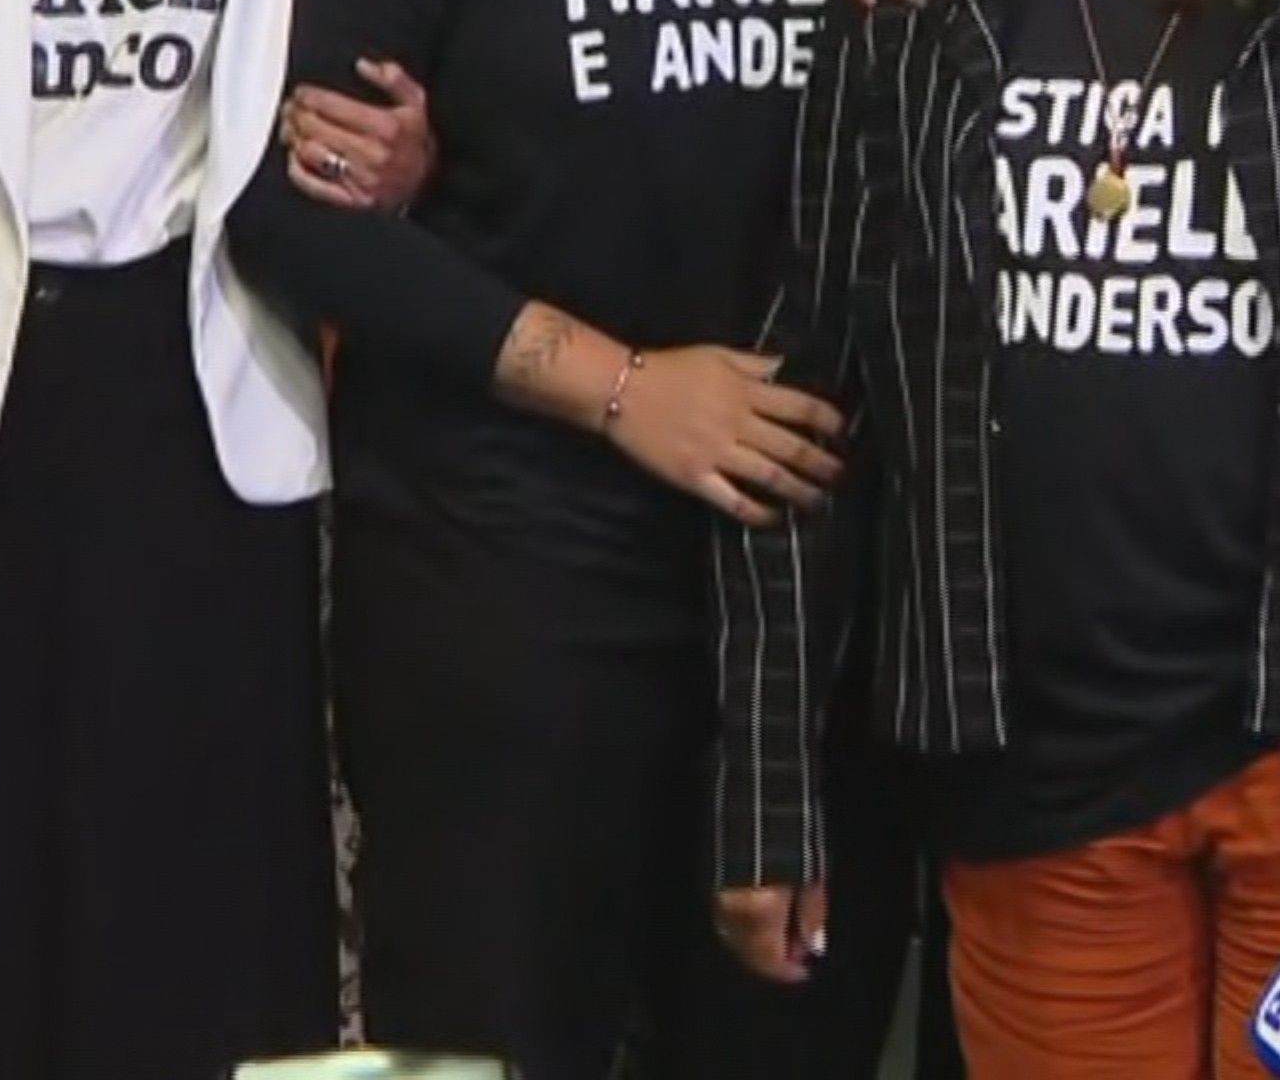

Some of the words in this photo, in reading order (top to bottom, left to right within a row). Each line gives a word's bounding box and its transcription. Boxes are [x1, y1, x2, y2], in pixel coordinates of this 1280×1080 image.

[568, 29, 612, 104] E
[650, 15, 826, 92] ANDE
[994, 76, 1174, 151] STIÇA
